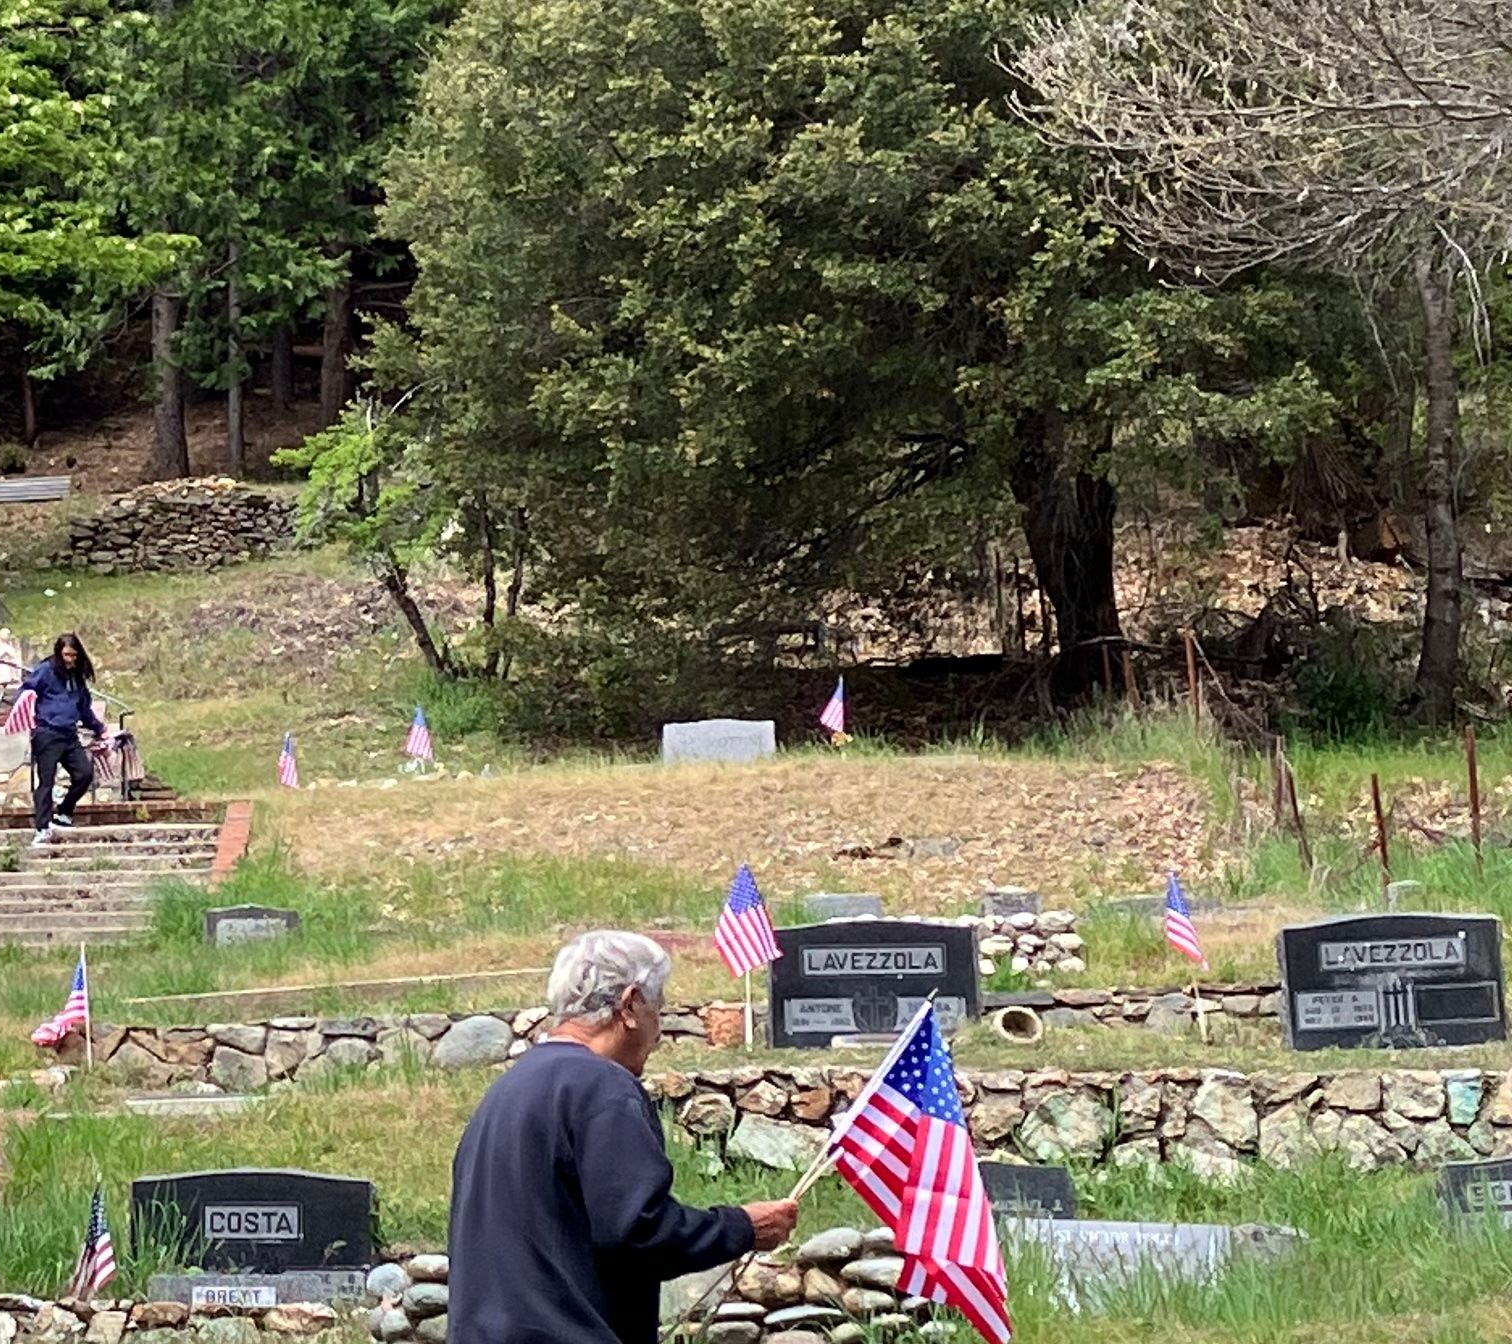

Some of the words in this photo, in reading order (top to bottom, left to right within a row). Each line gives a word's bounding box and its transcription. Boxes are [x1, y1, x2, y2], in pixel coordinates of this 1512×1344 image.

[807, 951, 939, 972] LAVEZZOLA
[1324, 941, 1460, 966] LAVEZZOLA
[209, 1211, 294, 1234] COSTA
